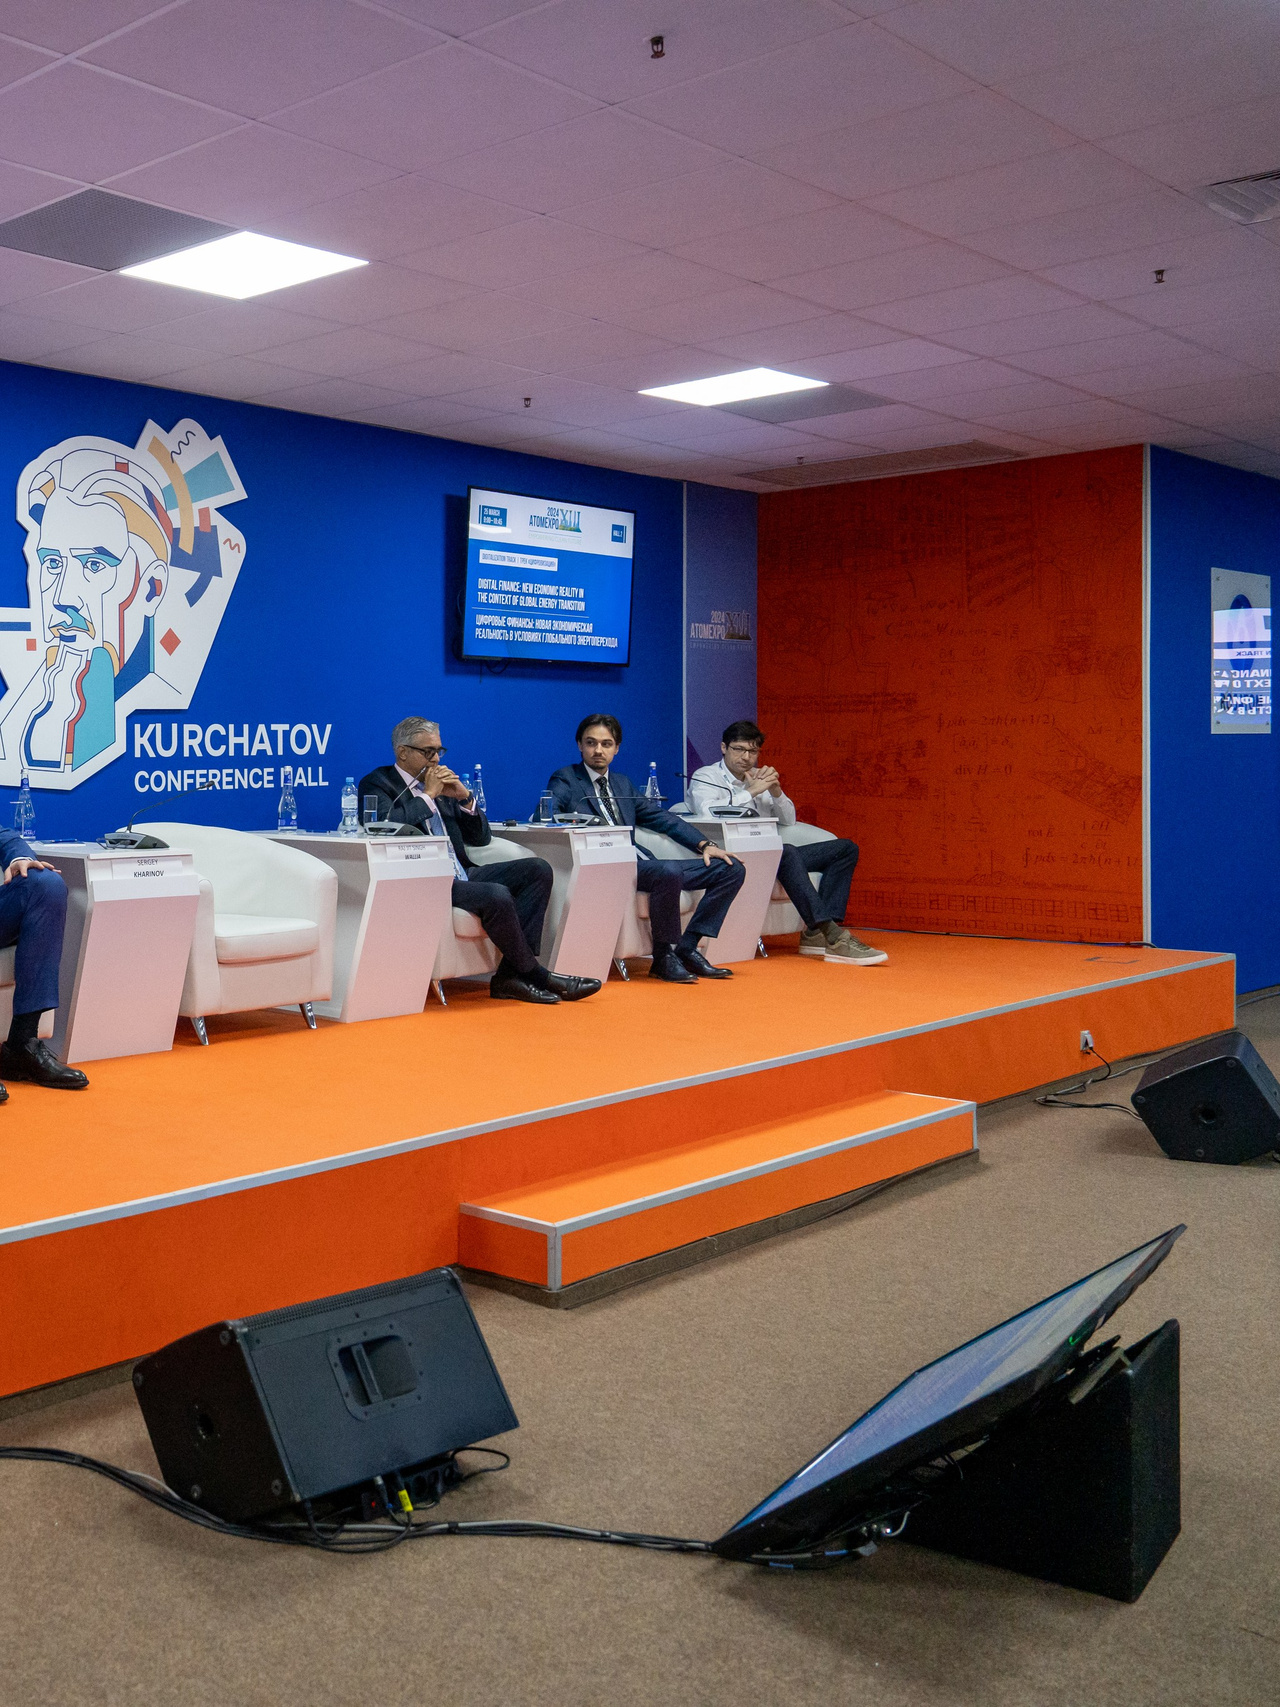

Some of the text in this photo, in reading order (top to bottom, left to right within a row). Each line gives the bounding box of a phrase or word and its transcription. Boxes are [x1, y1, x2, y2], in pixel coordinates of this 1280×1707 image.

[547, 507, 559, 517] 2024
[529, 515, 559, 530] ATOMEXPO
[478, 578, 498, 590] DIGITAL
[522, 582, 534, 594] NEW
[534, 583, 559, 596] ECONOMIC
[559, 586, 579, 598] REALITY
[579, 588, 585, 599] IN
[478, 591, 586, 611] THE CONTEXT OF GLOBAL ENERGY TRANSITION
[476, 614, 506, 627] ЦИФРОВЫЕ
[535, 619, 552, 630] НОВАЯ
[475, 628, 509, 641] РЕАЛЬНОСТЬ
[514, 631, 542, 642] УСЛОВИЯХ
[542, 633, 577, 645] ГЛОБАЛЬНОГО
[577, 635, 618, 648] ЭНЕРГОПЕРЕХОДА
[134, 723, 332, 758] KURCHATOV
[134, 768, 275, 793] CONFERENCE
[133, 870, 164, 878] KHARINOV
